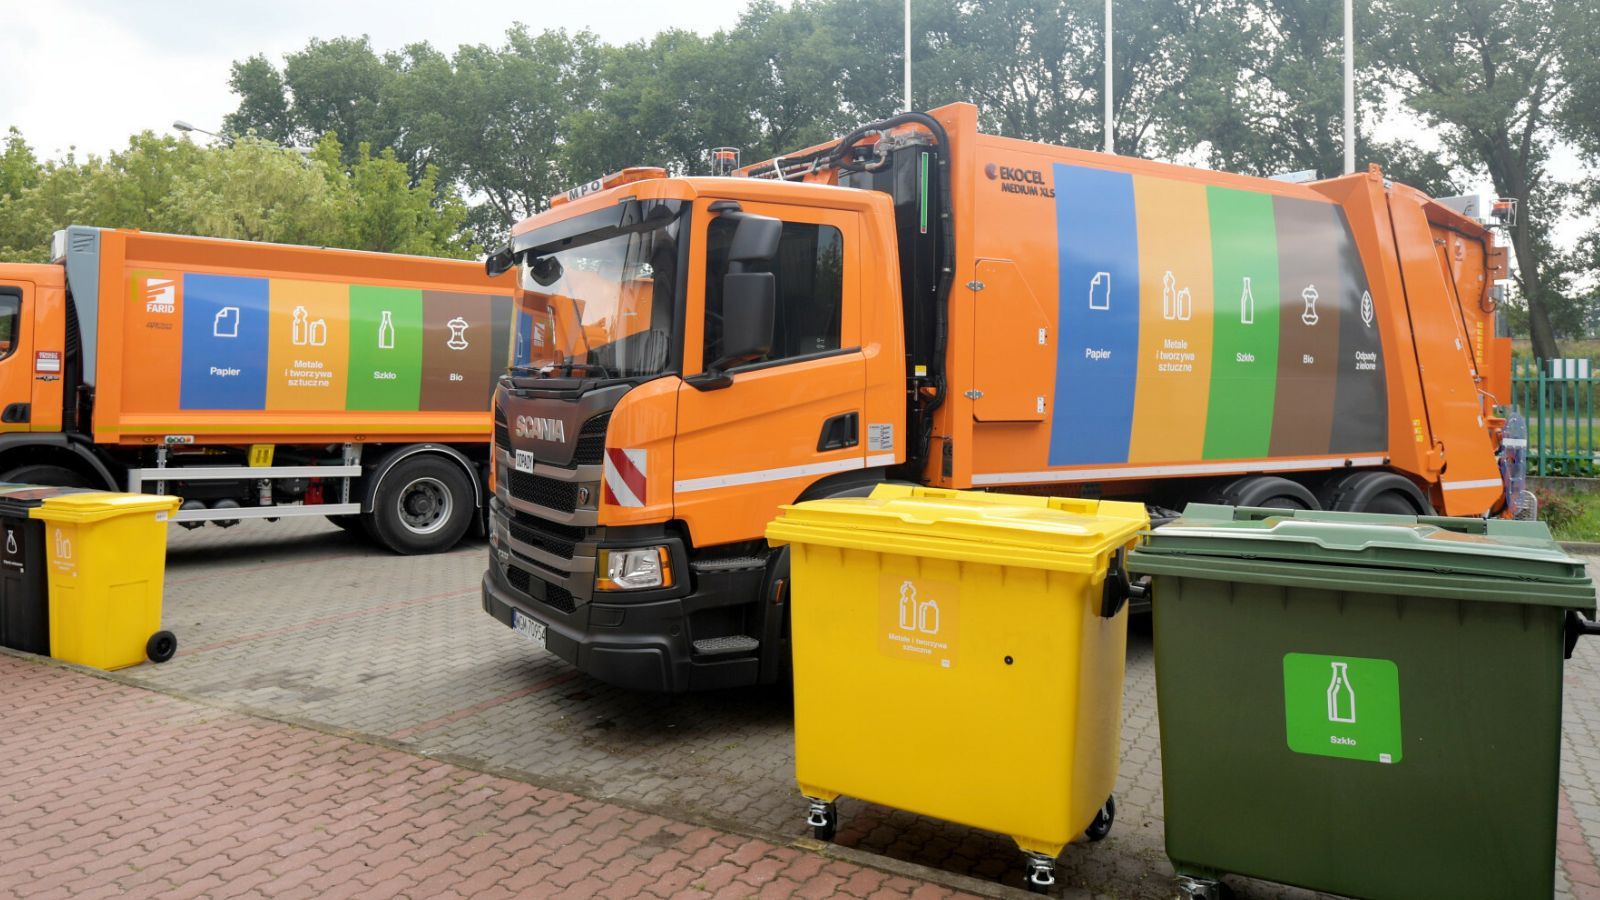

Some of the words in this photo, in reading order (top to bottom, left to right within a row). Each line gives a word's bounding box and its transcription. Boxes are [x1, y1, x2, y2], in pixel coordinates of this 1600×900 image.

[1000, 166, 1045, 185] EKOCEL
[569, 180, 601, 201] MPO
[1001, 183, 1039, 196] MEDIUM
[1040, 187, 1056, 198] XLS
[146, 304, 176, 314] FARID
[1164, 339, 1188, 350] Metale
[1085, 348, 1111, 360] Papier
[1160, 351, 1195, 363] tworzywa
[1235, 352, 1256, 362] Szkło
[1302, 354, 1314, 365] Bio
[1355, 351, 1377, 363] Odpady
[294, 360, 324, 369] Metale
[1158, 363, 1193, 372] sztuczne
[1355, 361, 1376, 371] zielone
[210, 366, 241, 378] Papier
[289, 369, 333, 380] tworzywa
[450, 373, 464, 382] Bio
[287, 379, 330, 388] sztuczne
[515, 415, 566, 444] SCANIA
[1330, 735, 1357, 746] Szkło
